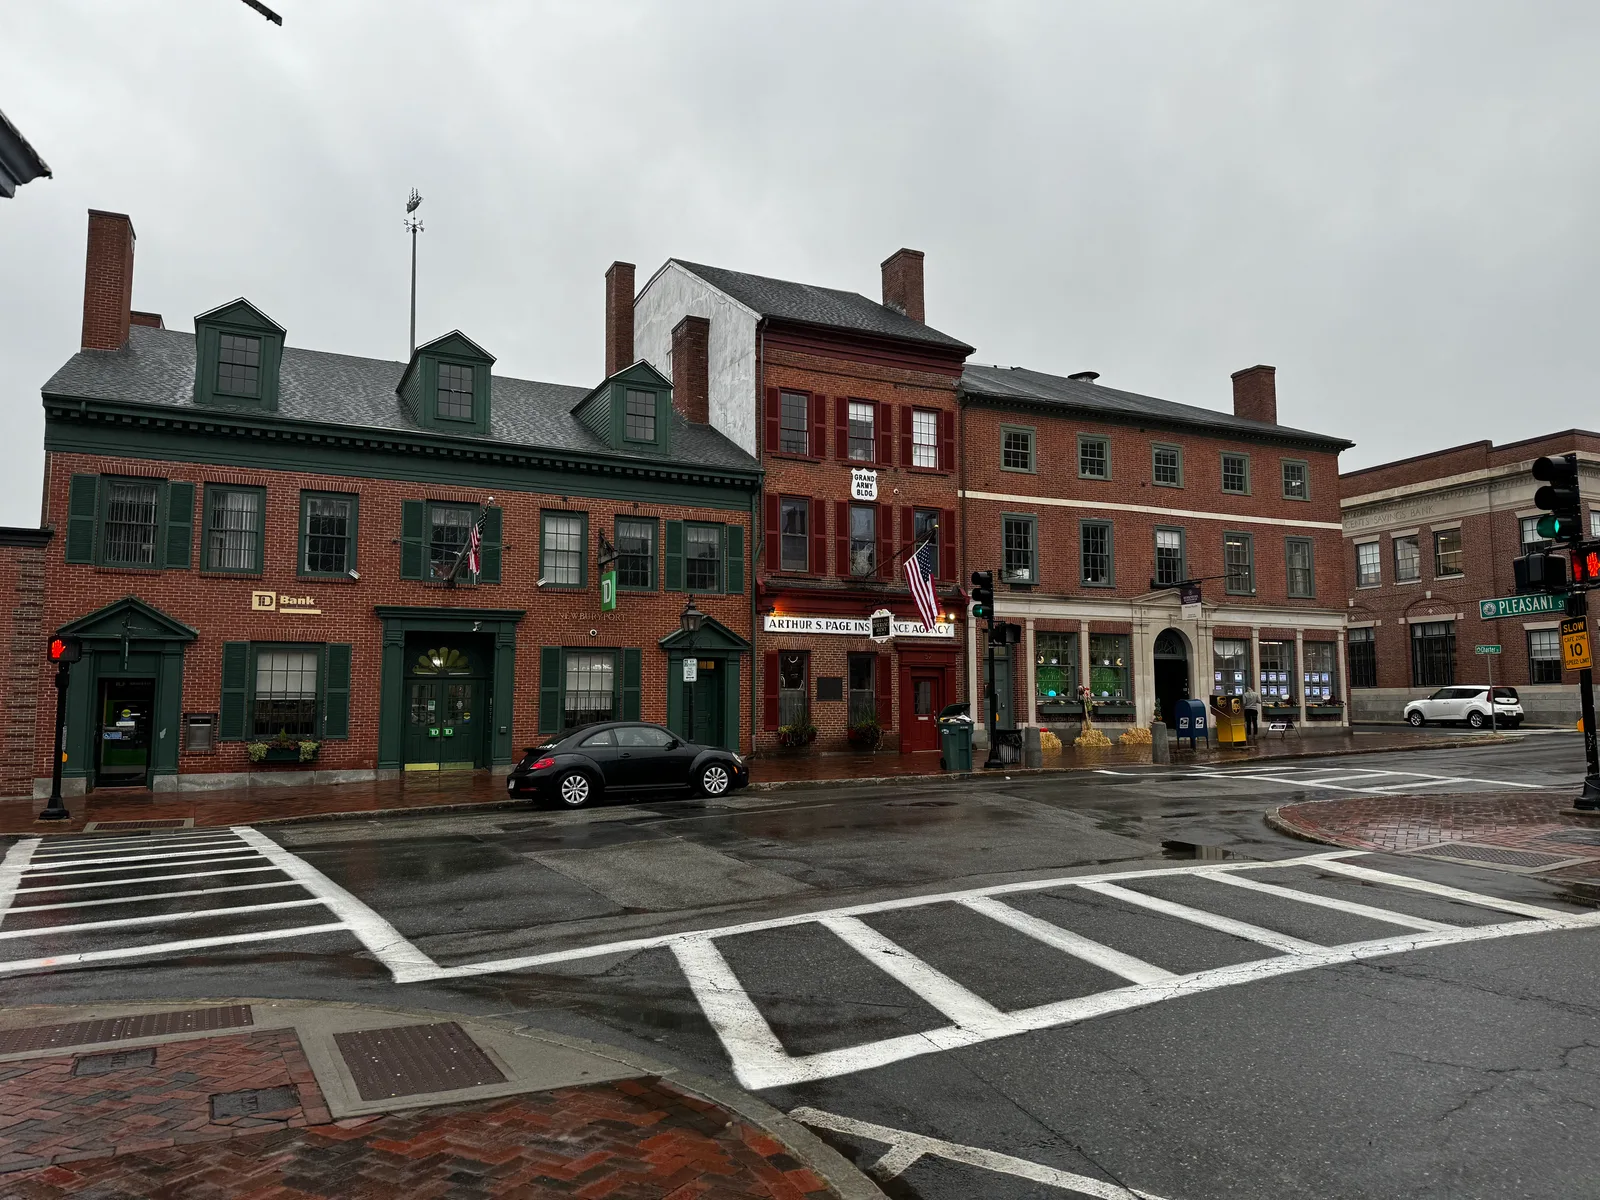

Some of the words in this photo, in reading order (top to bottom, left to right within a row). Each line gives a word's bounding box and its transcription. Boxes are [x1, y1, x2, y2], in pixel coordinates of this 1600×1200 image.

[854, 474, 875, 482] GRAND
[856, 489, 874, 497] BLDG.
[1374, 511, 1407, 524] SAVINGS
[1410, 505, 1435, 517] BANK
[602, 579, 612, 604] TD
[254, 594, 274, 607] TD
[280, 595, 315, 605] Bank
[1499, 595, 1554, 615] PLEASANT
[559, 612, 625, 621] NEWBURYPORT
[769, 619, 813, 630] ARTHUR
[815, 621, 823, 630] S.
[826, 621, 852, 631] PAGE
[911, 624, 950, 634] AGNCY
[1563, 621, 1585, 633] SLOW
[1570, 643, 1583, 657] 10
[1566, 658, 1579, 666] SPEED
